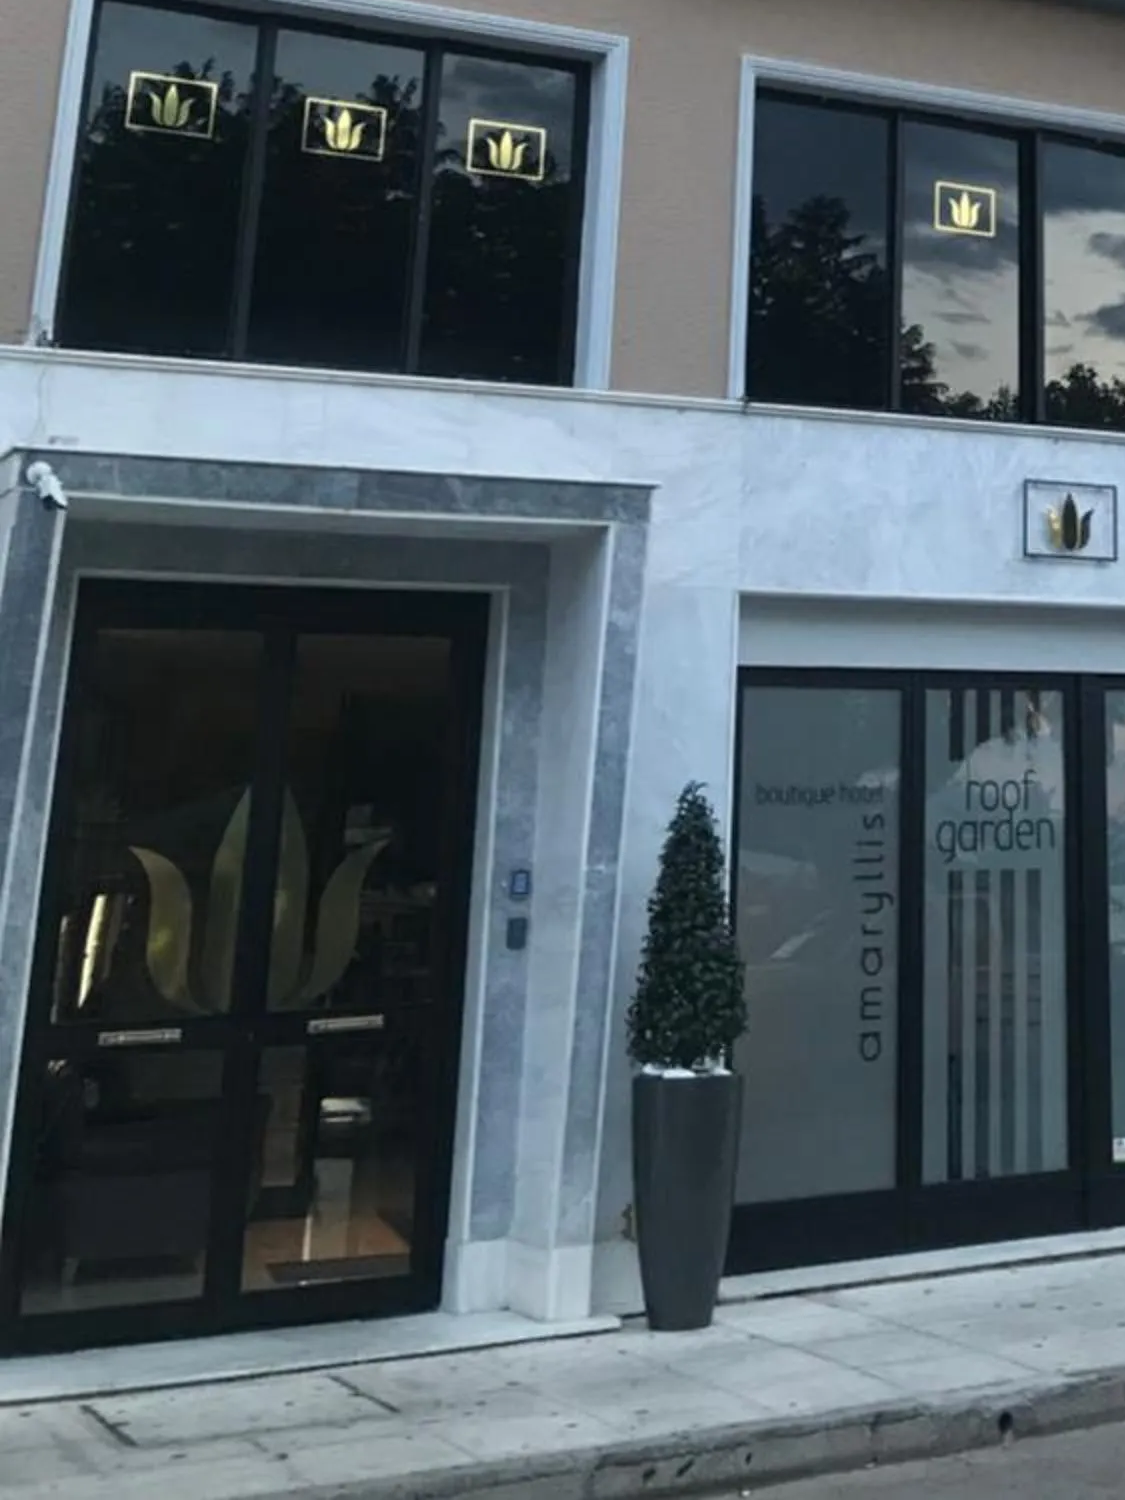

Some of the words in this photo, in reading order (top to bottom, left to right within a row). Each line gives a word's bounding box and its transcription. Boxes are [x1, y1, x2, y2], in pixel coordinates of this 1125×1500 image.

[755, 782, 835, 808] boutique
[965, 768, 1038, 812] roof
[935, 808, 1056, 865] garden
[853, 812, 894, 1063] amaryllis
